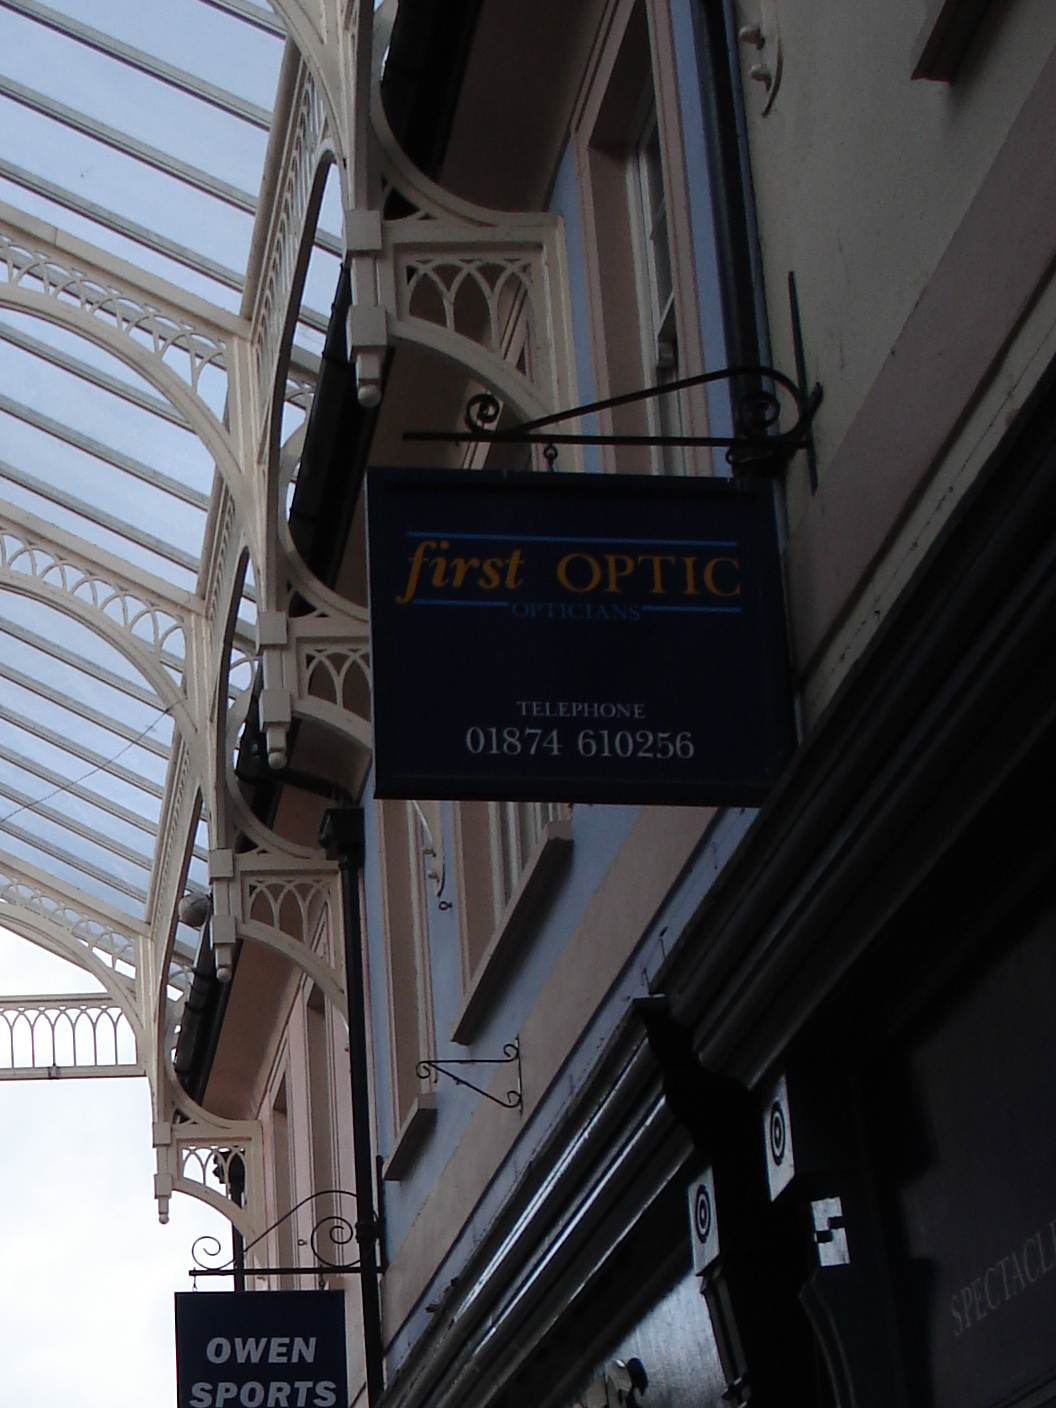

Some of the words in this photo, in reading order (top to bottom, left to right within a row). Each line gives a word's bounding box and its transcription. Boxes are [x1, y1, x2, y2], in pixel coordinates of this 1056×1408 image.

[395, 540, 526, 604] first
[556, 553, 742, 598] OPTIC
[511, 601, 641, 622] OPTICIANS
[516, 701, 646, 719] TELEPHONE
[465, 726, 563, 756] 01874
[577, 729, 695, 760] 610256
[206, 1336, 317, 1364] OWEN
[189, 1381, 337, 1408] SPORTS
